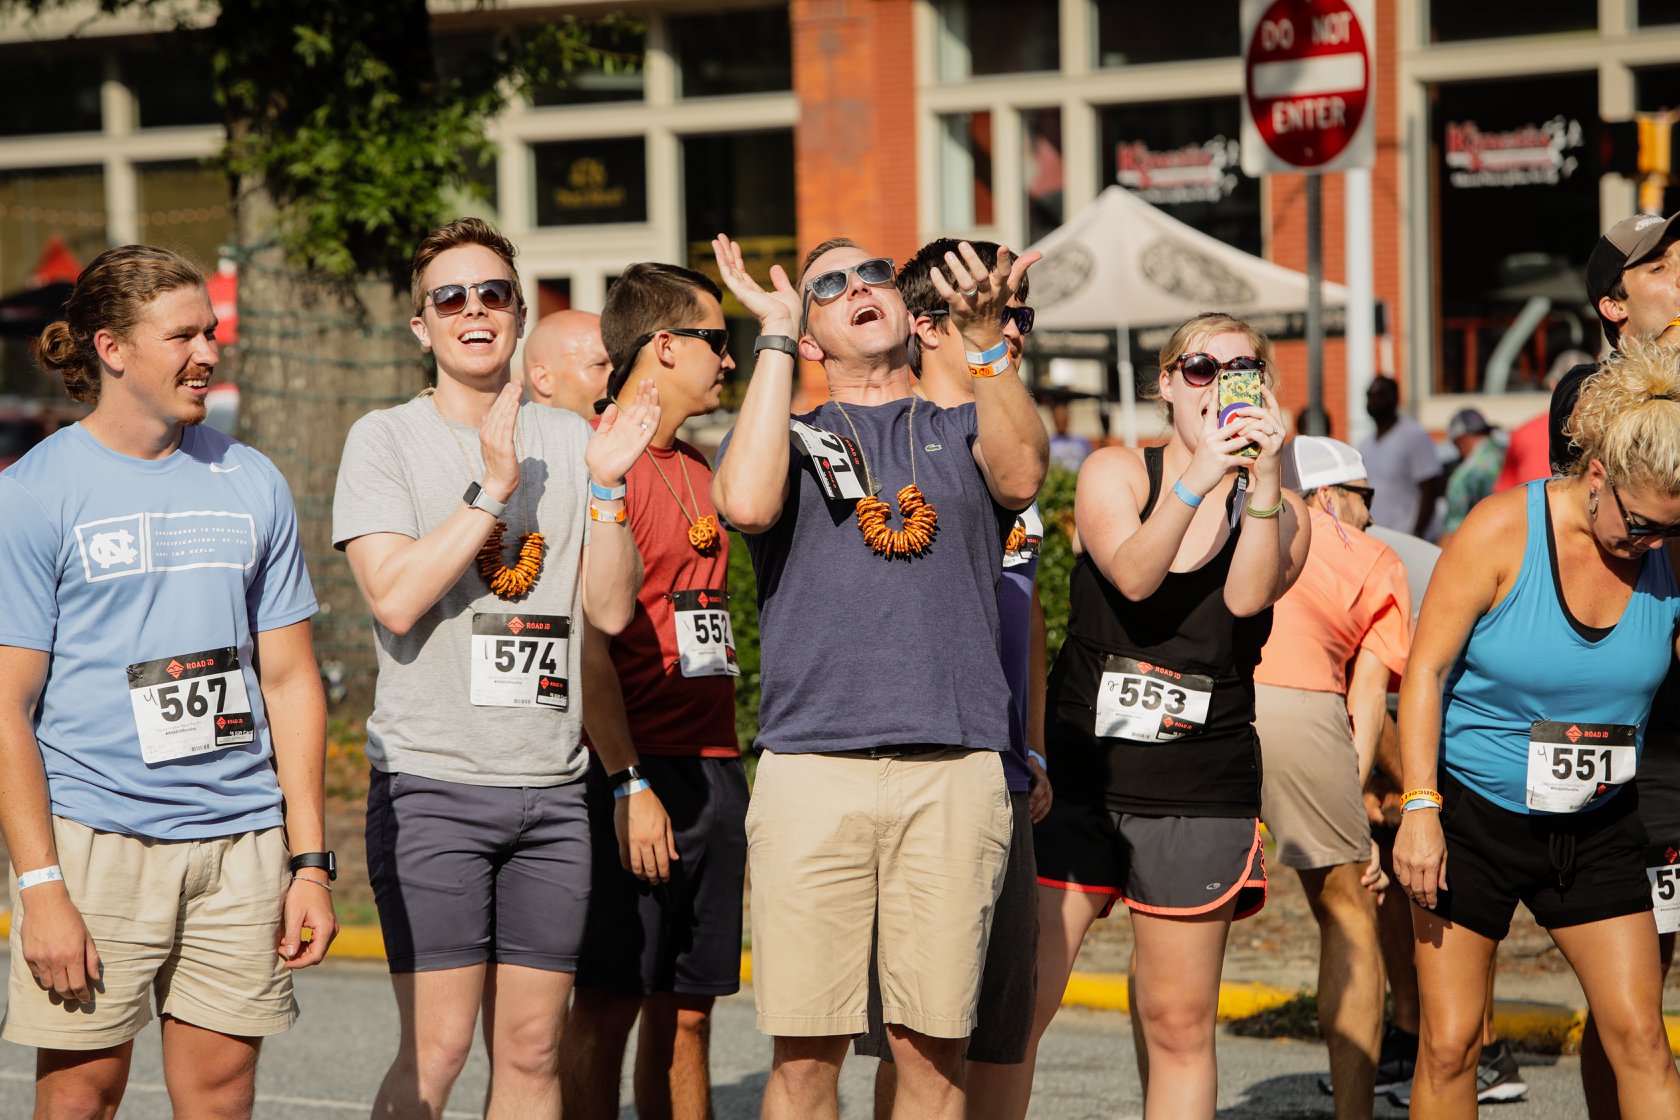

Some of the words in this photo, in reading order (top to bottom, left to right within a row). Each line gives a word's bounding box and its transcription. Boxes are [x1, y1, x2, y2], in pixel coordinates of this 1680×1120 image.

[1261, 18, 1294, 50] DO
[1312, 11, 1352, 46] NOT
[1272, 96, 1346, 134] ENTER
[804, 423, 851, 473] 71
[693, 613, 730, 644] 552
[186, 660, 206, 670] ROAD
[494, 639, 556, 674] 574
[1155, 666, 1173, 678] ROAD
[157, 676, 227, 722] 567
[1118, 677, 1187, 715] 553
[1552, 747, 1612, 782] 551
[1656, 867, 1680, 901] 5
